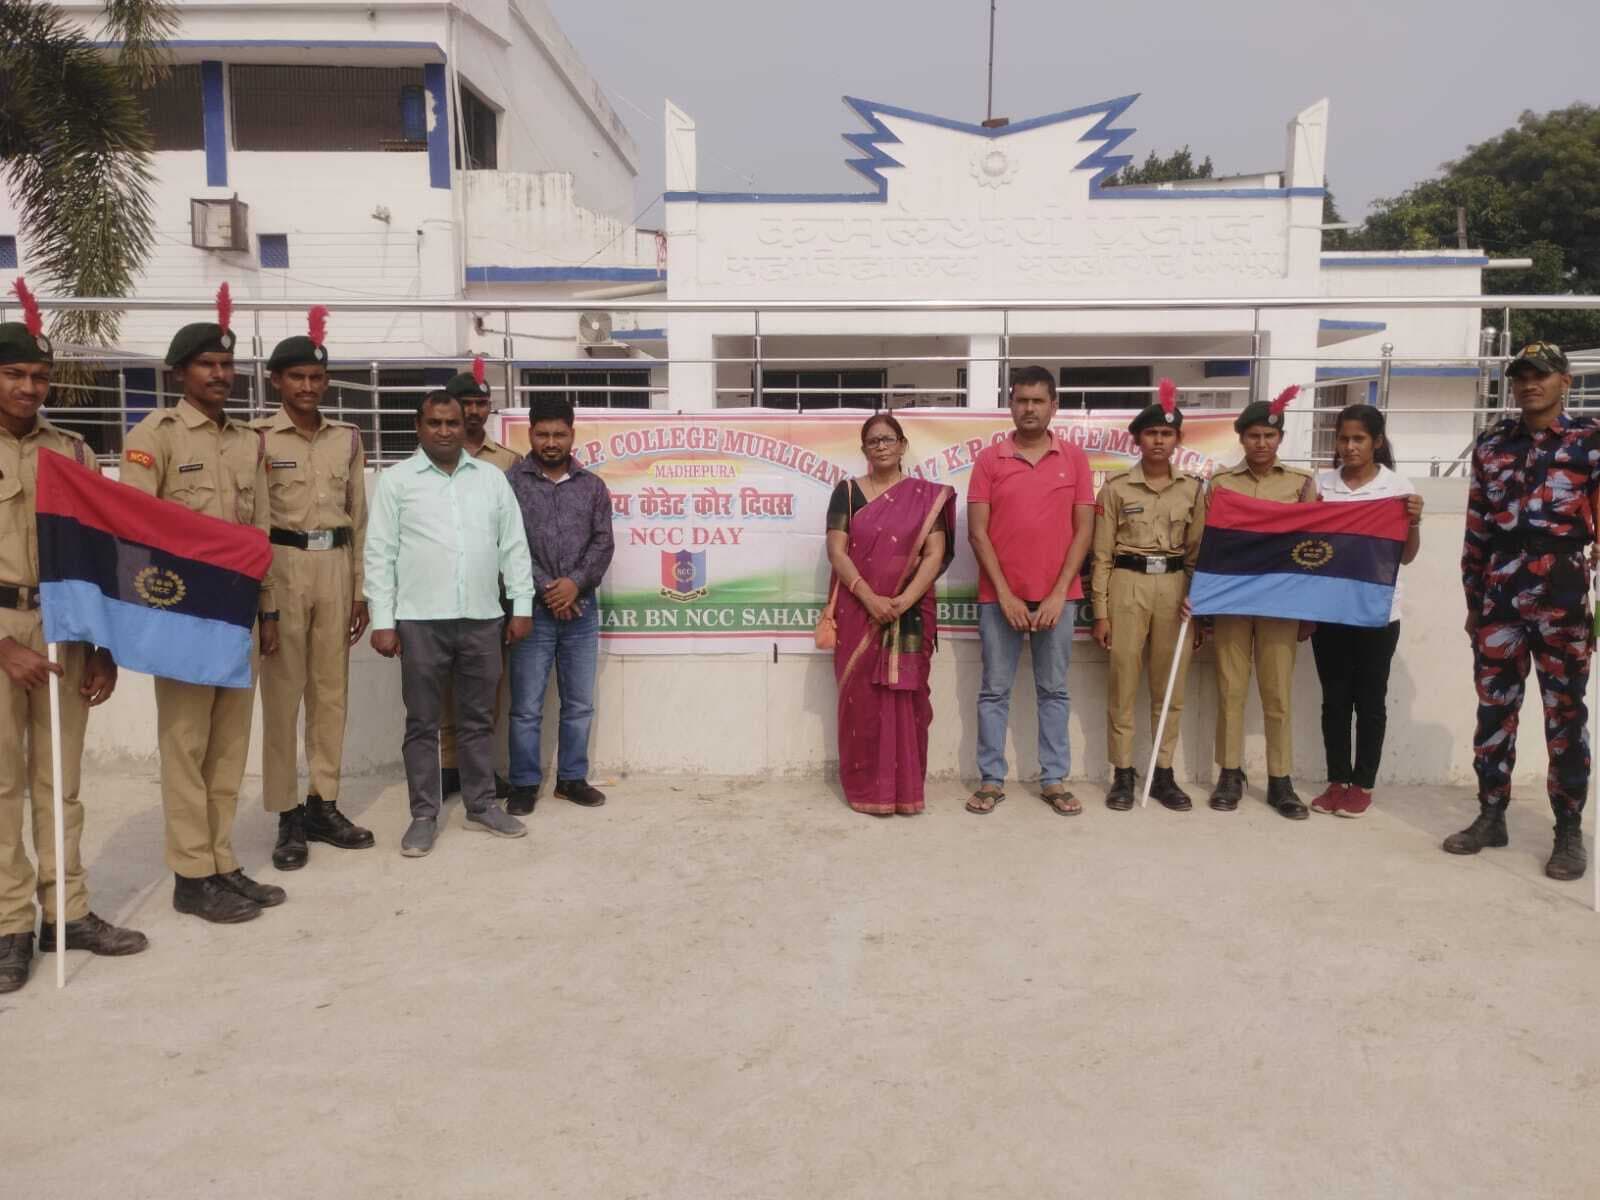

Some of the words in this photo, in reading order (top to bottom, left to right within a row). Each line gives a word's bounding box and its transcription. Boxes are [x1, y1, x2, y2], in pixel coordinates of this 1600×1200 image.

[610, 427, 718, 457] COLLEGE
[130, 452, 150, 464] NCC
[655, 464, 736, 479] MADHEPURA
[638, 486, 686, 516] कैडेट
[739, 486, 794, 516] दिवस
[629, 527, 684, 545] NCC
[692, 527, 744, 545] DAY
[645, 608, 678, 627] BN
[685, 608, 734, 626] NCC
